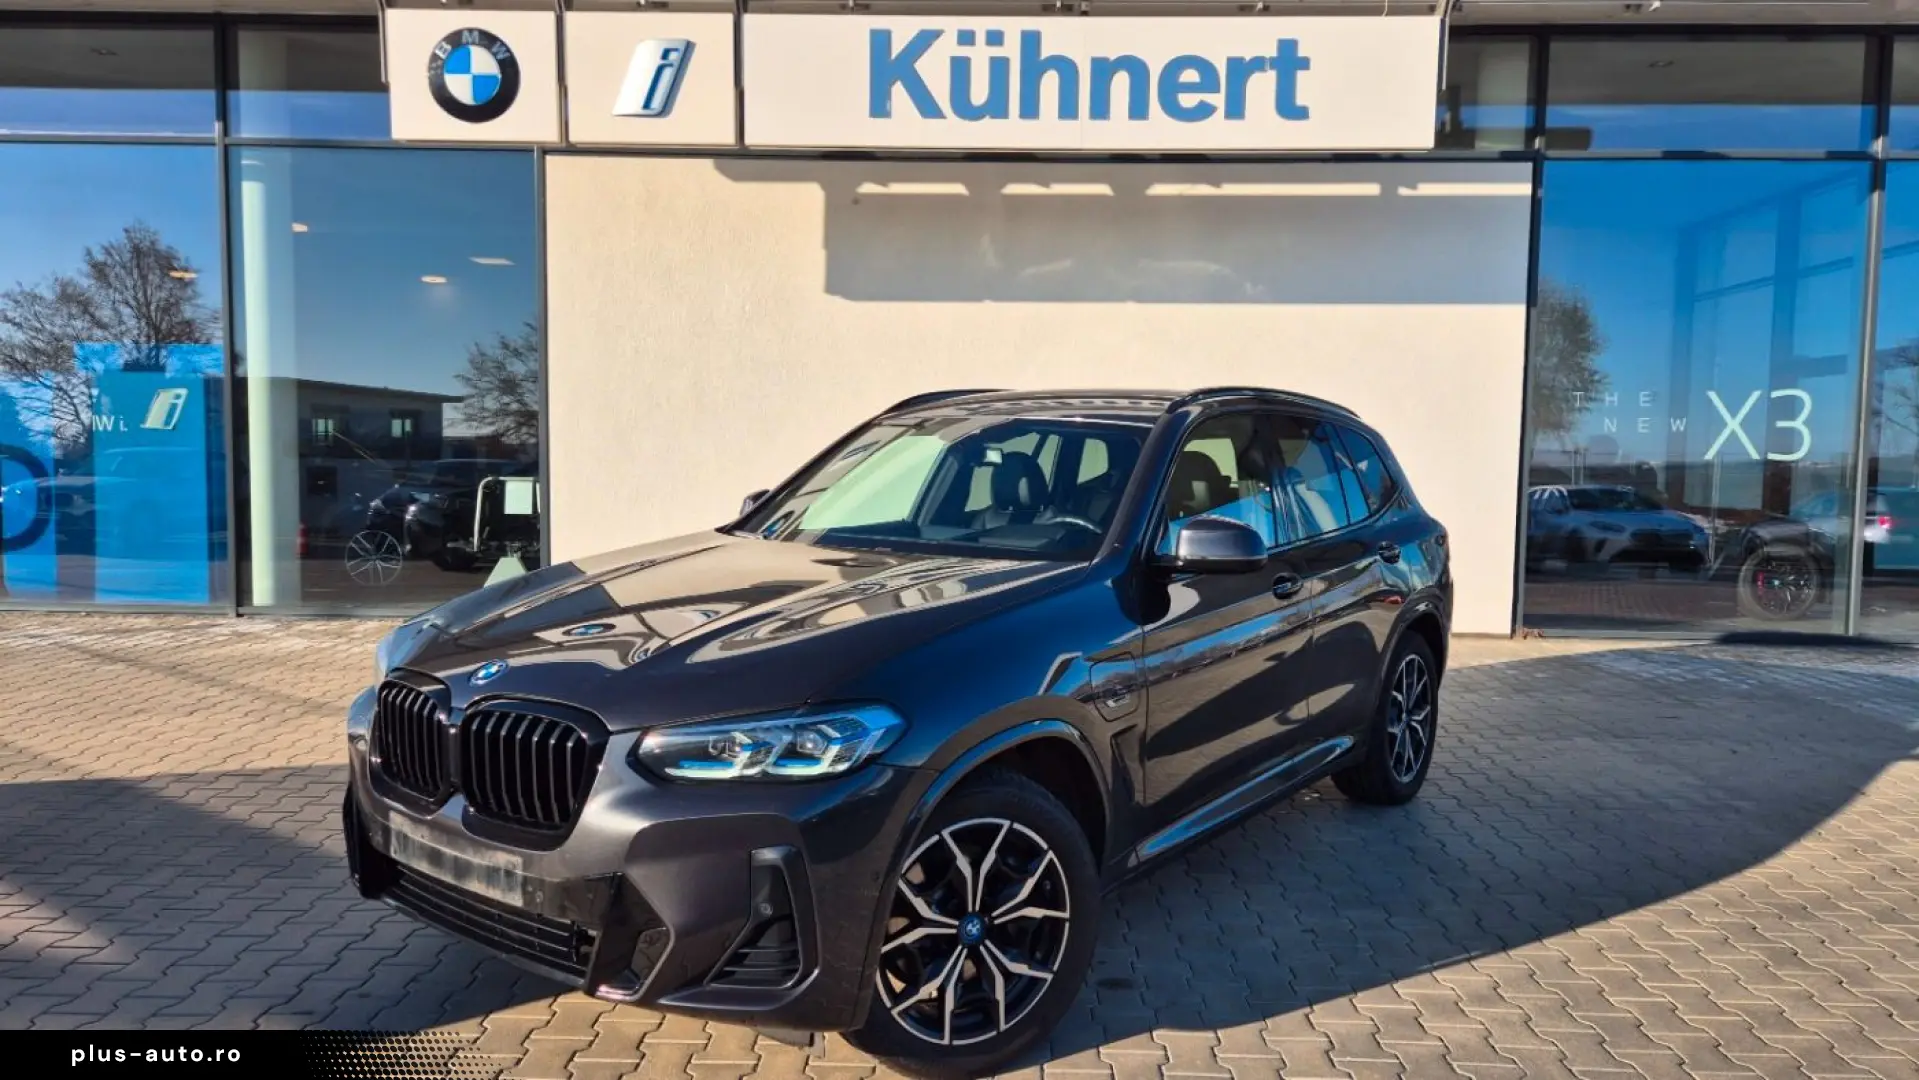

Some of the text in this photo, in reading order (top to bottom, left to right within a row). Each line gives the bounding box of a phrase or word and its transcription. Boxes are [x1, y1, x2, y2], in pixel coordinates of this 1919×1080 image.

[435, 29, 511, 61] BMW
[868, 28, 1311, 123] Kühnert
[1572, 391, 1653, 407] THE
[1603, 416, 1687, 434] NEW
[1703, 388, 1813, 461] X3
